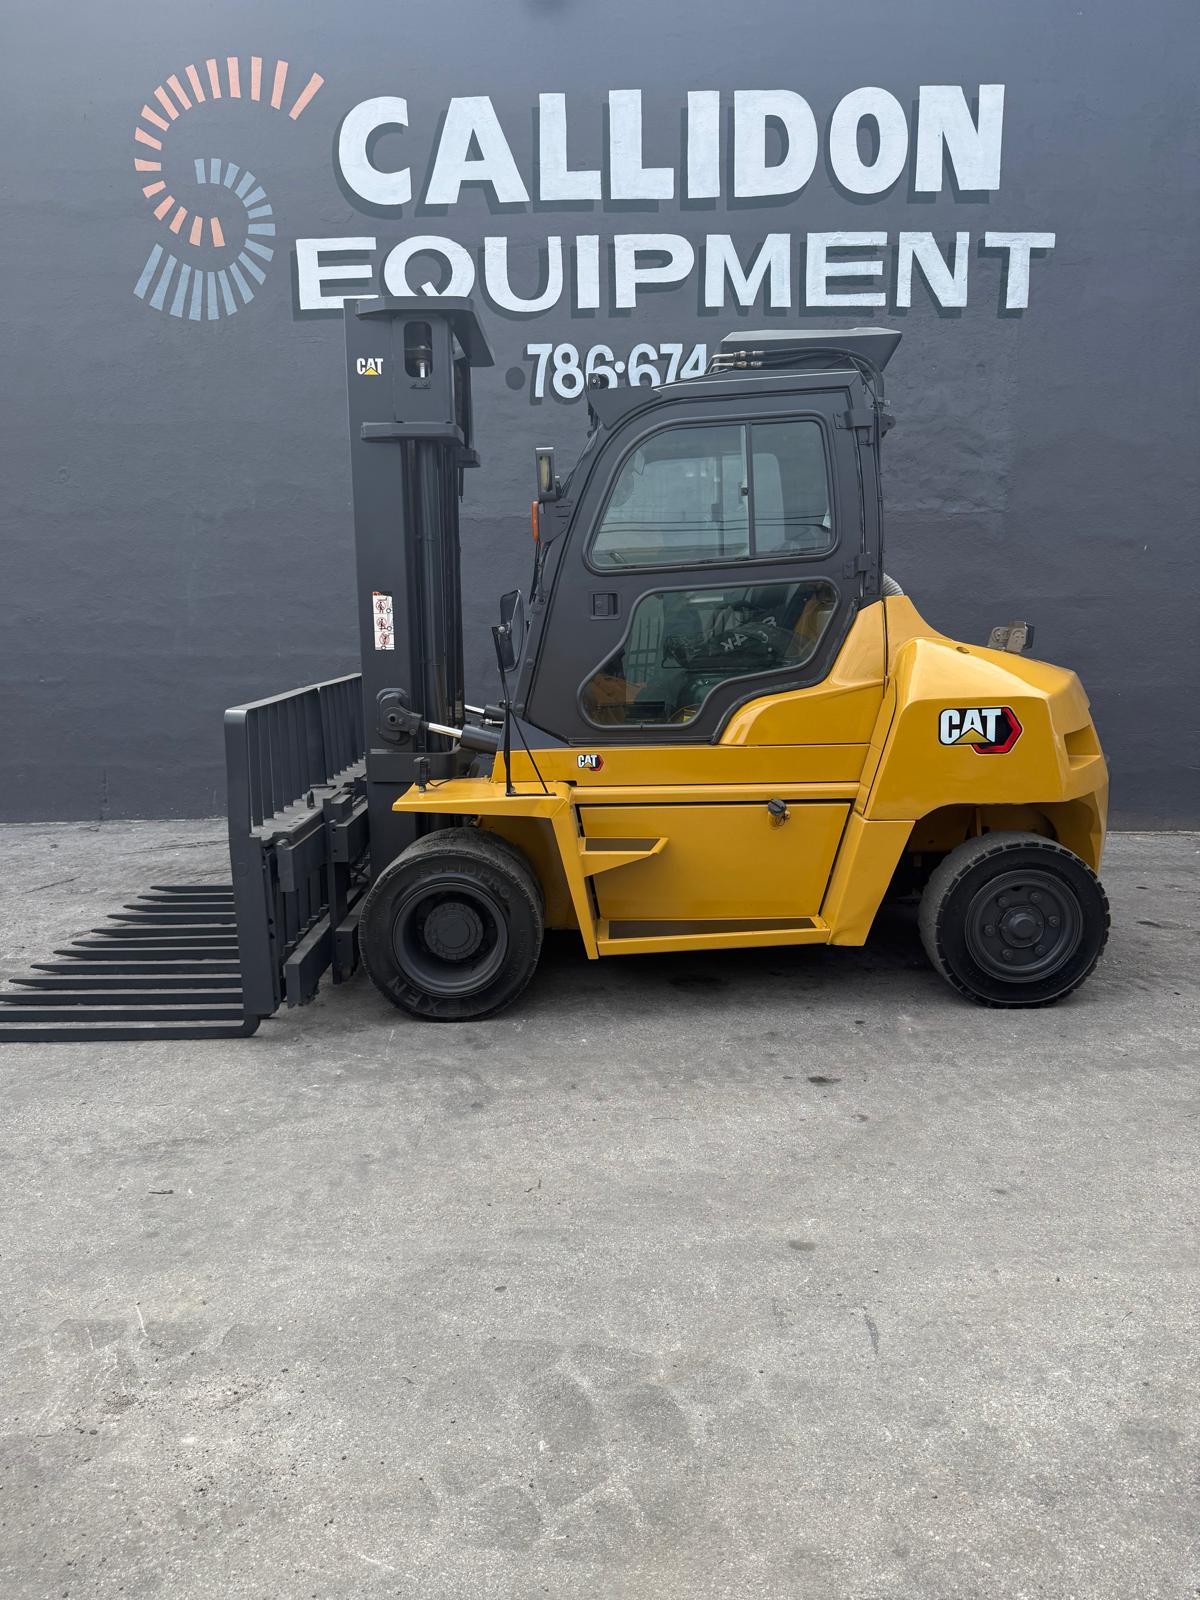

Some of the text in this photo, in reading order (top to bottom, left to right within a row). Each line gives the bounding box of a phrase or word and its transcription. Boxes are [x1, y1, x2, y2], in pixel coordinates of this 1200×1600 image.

[337, 84, 1005, 206] CALLIDON
[294, 231, 1057, 313] EQUIPMENT
[356, 357, 384, 376] CAT
[939, 708, 1002, 745] CAT
[577, 754, 598, 768] CAT
